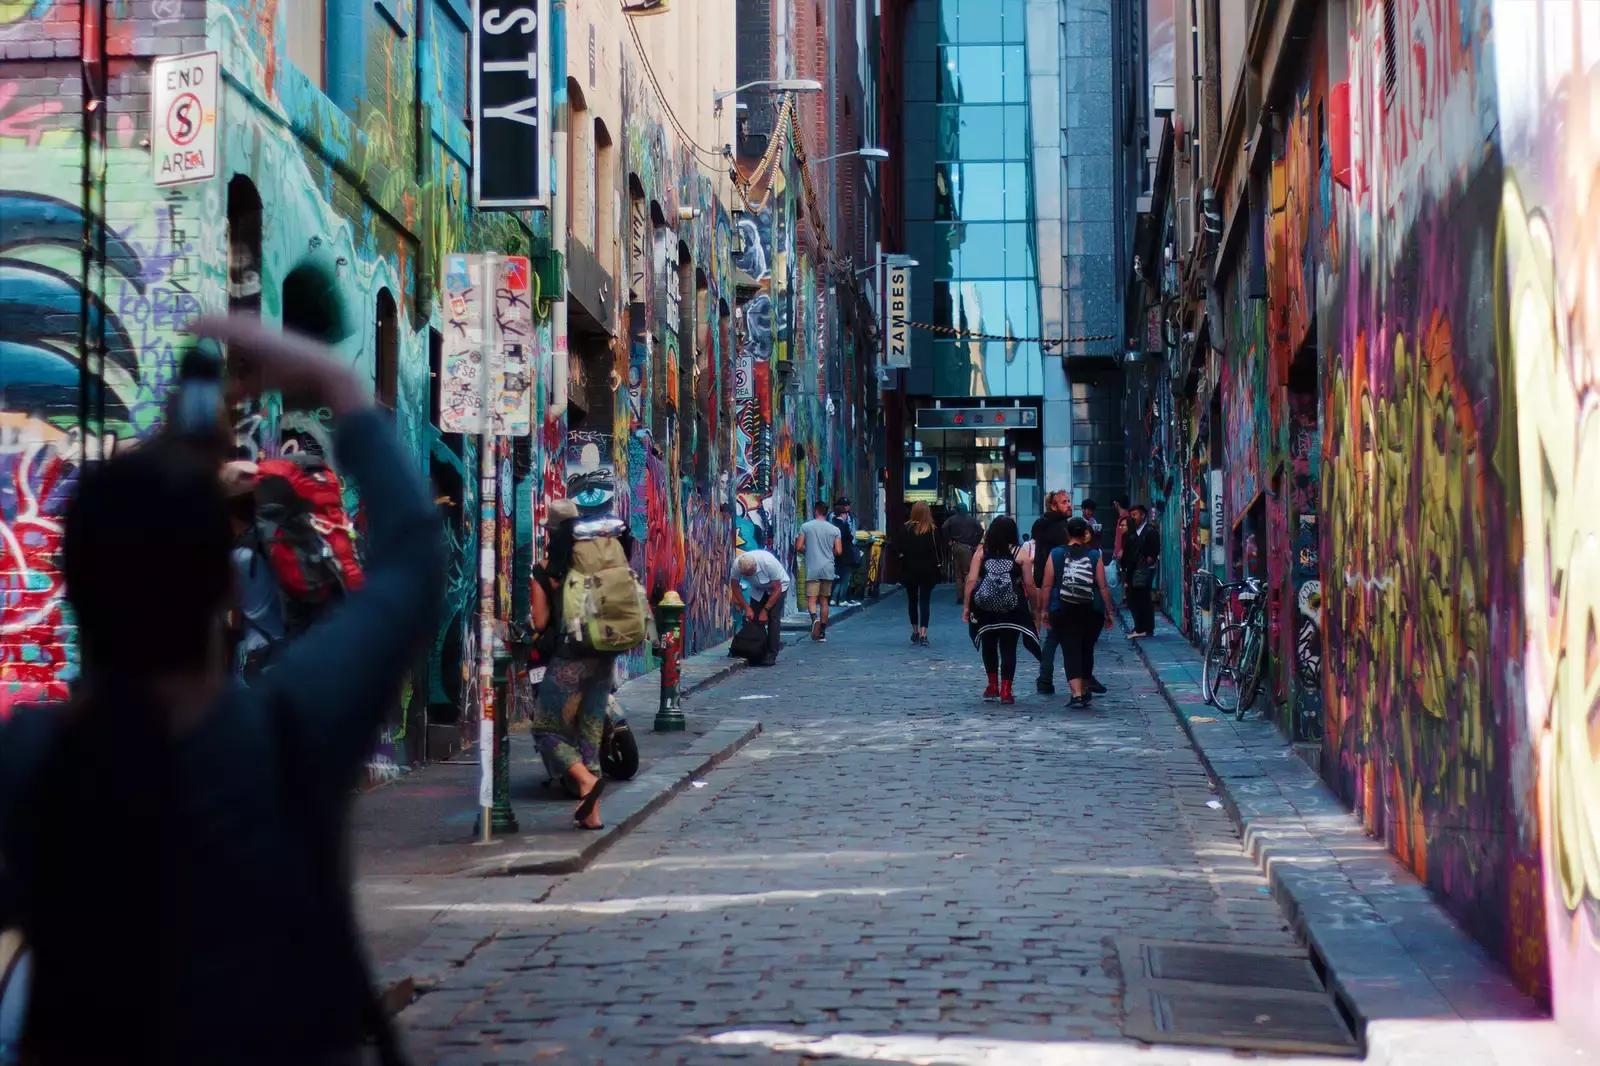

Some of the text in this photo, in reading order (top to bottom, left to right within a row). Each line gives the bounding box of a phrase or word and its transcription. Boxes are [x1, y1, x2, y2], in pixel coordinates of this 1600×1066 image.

[167, 66, 203, 90] END
[482, 8, 537, 127] STY
[161, 149, 205, 174] AREA
[892, 266, 905, 356] ZAMBESI
[736, 388, 749, 396] REA
[909, 461, 932, 485] P
